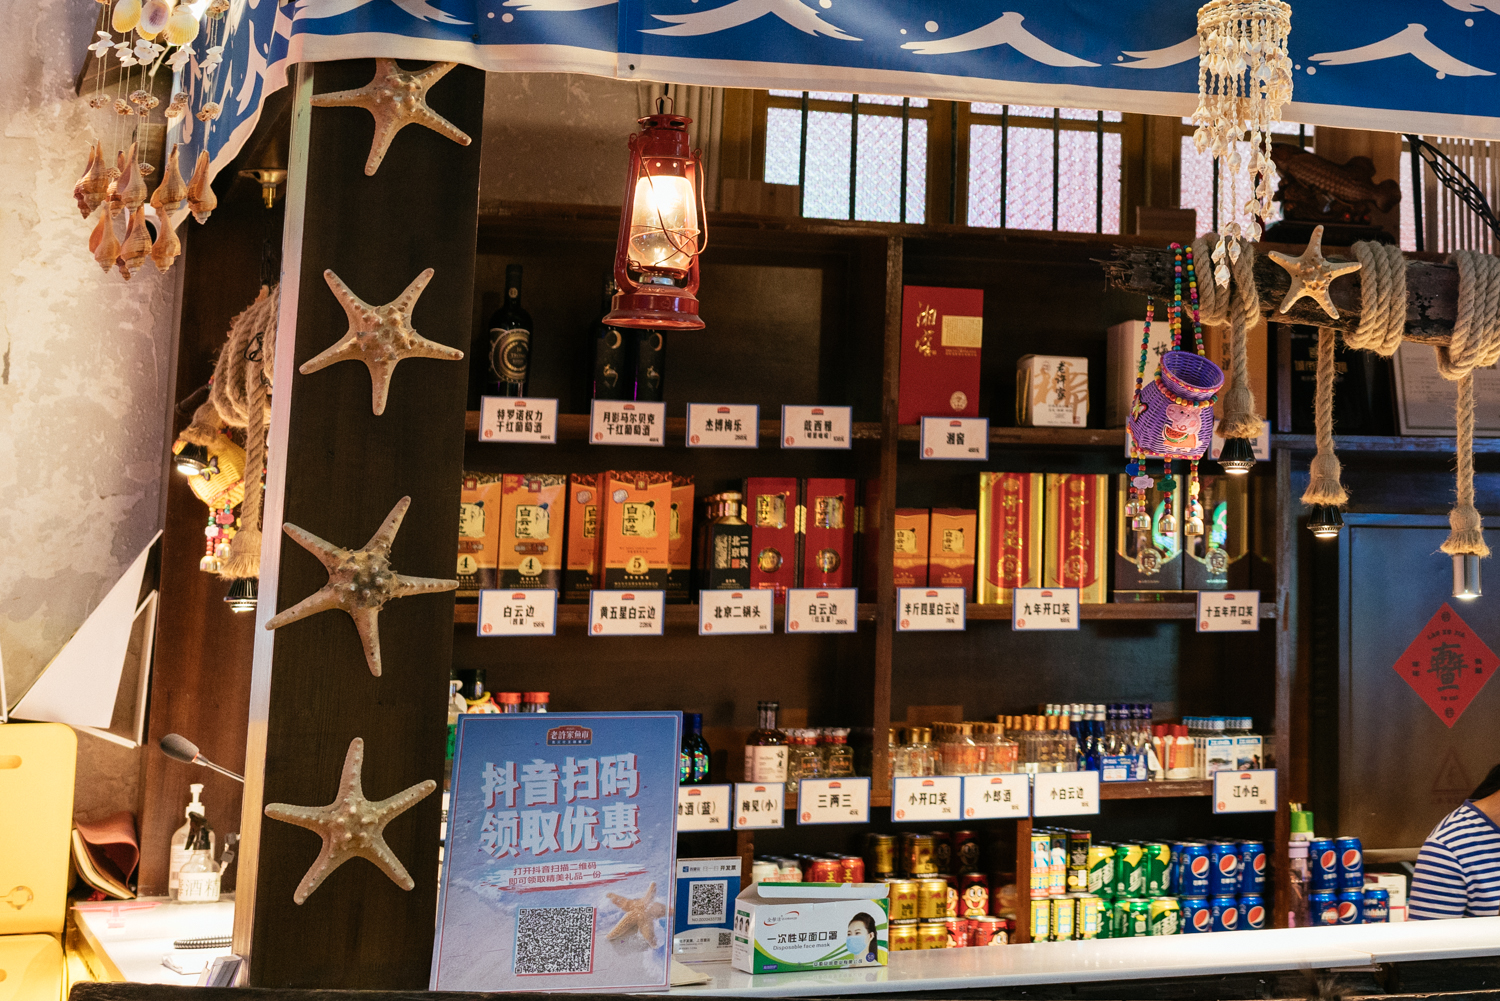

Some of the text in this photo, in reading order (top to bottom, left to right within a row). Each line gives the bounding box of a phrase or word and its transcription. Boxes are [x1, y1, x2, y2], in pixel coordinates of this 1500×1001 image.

[603, 411, 655, 425] 月影马尔贝克
[496, 421, 543, 434] 干红葡萄酒
[606, 424, 650, 436] 干红葡萄酒
[527, 558, 534, 569] 4
[633, 557, 641, 569] 5
[504, 605, 535, 618] 白云边
[600, 605, 656, 619] 黄五星白云边
[714, 606, 761, 619] 北京二锅头
[808, 603, 837, 616] 白云边
[904, 602, 960, 616] 半斤四星白云边
[1023, 603, 1070, 616] 九年开口笑
[1205, 606, 1254, 618] 十五年开口笑
[481, 753, 640, 809] 抖音扫码
[983, 789, 1012, 803] 小郎酒
[1051, 787, 1084, 800] 小白云边
[1233, 785, 1259, 798] 江小白
[818, 794, 851, 808] 三两三
[909, 792, 947, 806] 小开口笑
[480, 801, 641, 858] 领取优惠
[513, 861, 597, 876] 打开抖音扫描二维码
[508, 870, 602, 885] 即可领取精美礼品一份
[767, 930, 838, 945] 一次性平面口罩
[773, 943, 803, 951] Disposable
